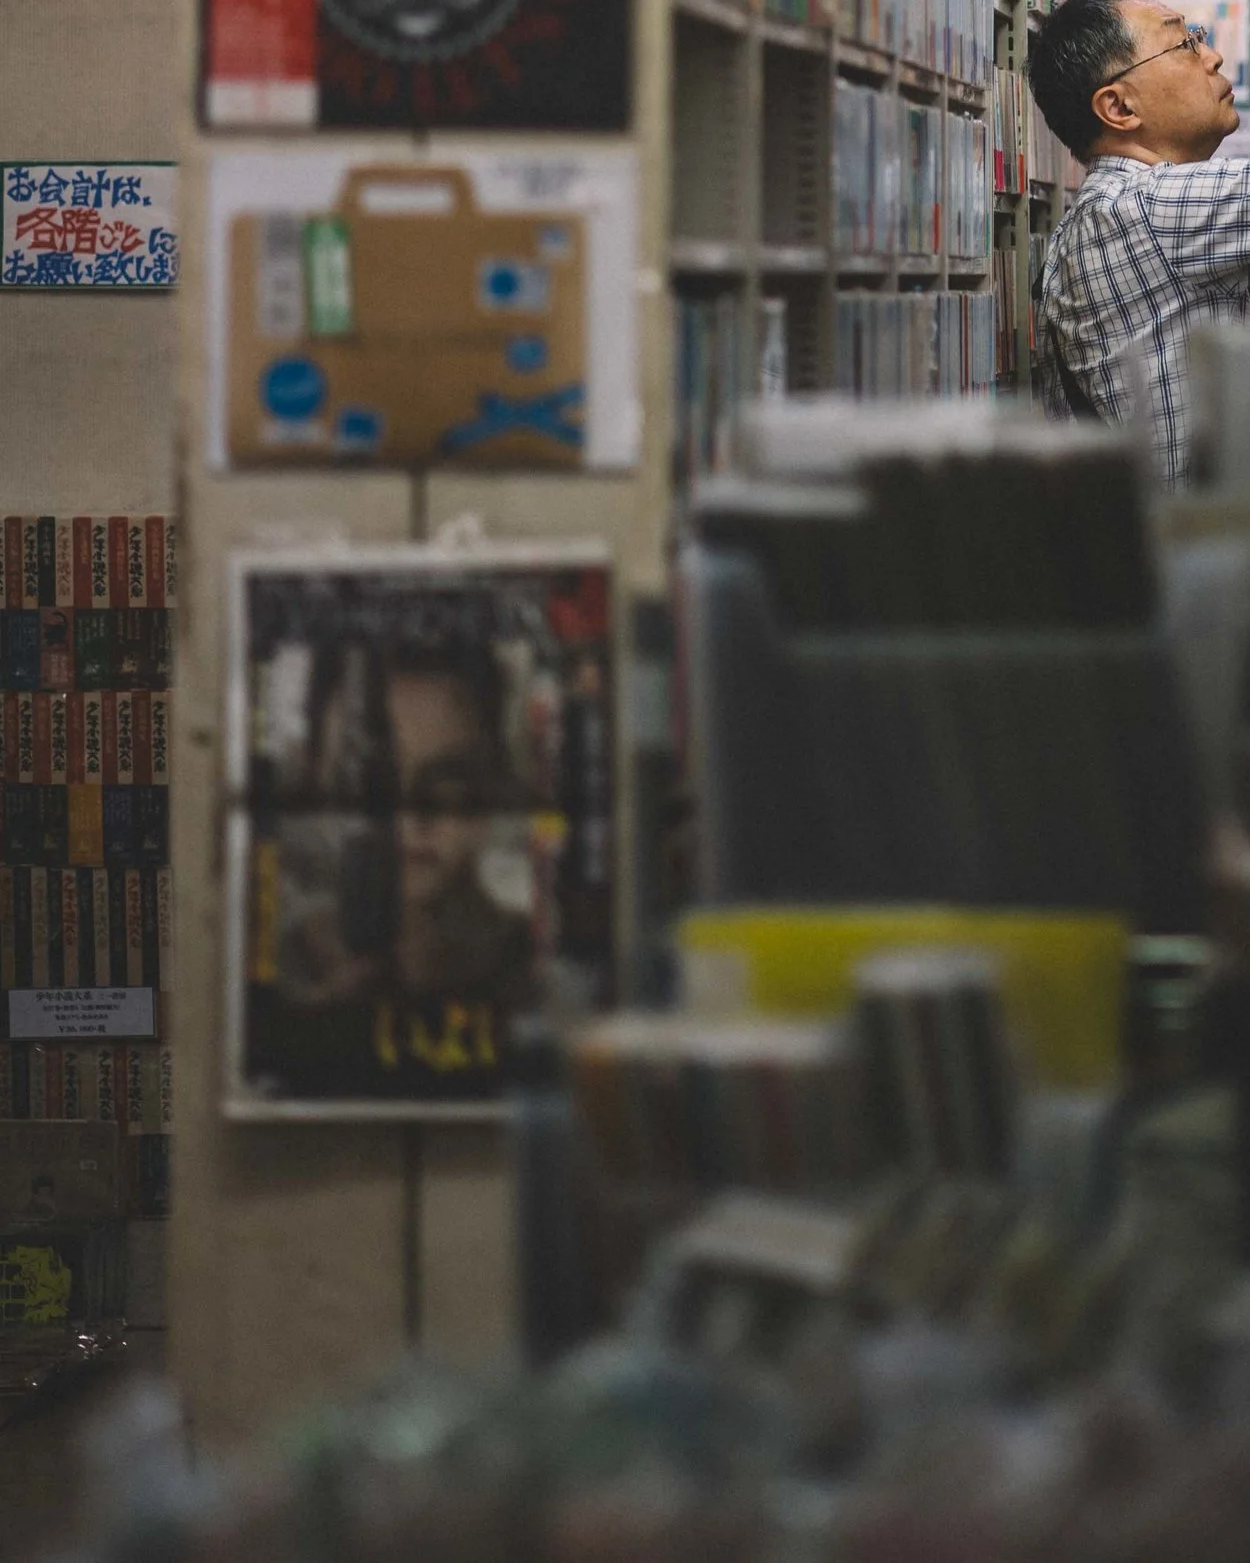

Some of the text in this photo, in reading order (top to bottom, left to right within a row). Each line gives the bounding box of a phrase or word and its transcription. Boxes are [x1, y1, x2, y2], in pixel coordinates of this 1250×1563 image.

[16, 206, 178, 255] 各階ごとに
